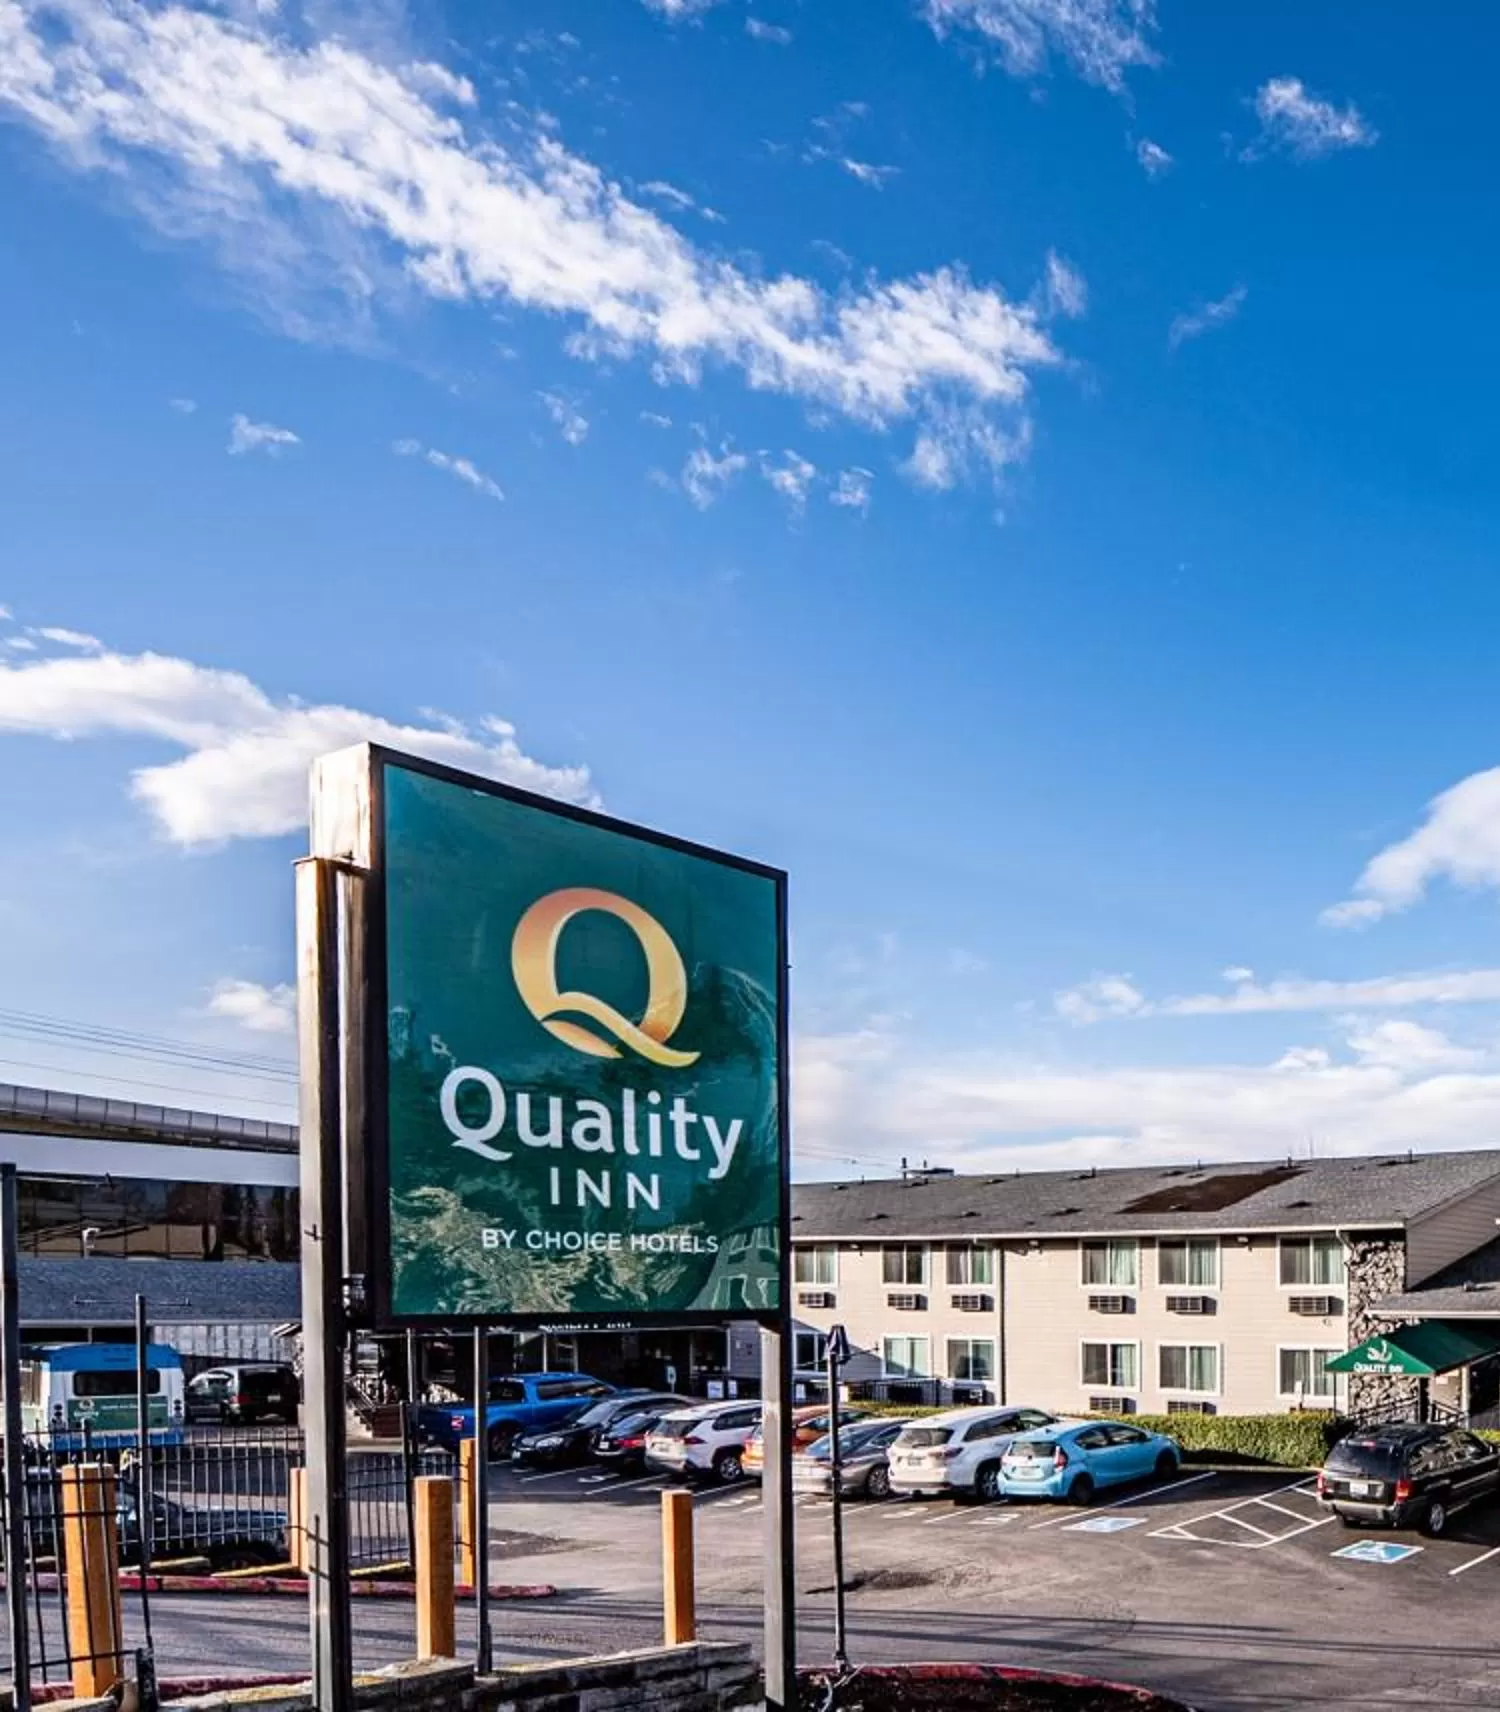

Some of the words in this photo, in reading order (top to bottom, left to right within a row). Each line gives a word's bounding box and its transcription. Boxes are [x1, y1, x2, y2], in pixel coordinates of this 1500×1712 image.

[511, 887, 701, 1067] Q
[440, 1066, 743, 1178] Quality
[550, 1167, 660, 1210] INN
[481, 1229, 516, 1248] BY
[525, 1231, 622, 1250] CHOICE
[630, 1234, 719, 1253] HOTELS
